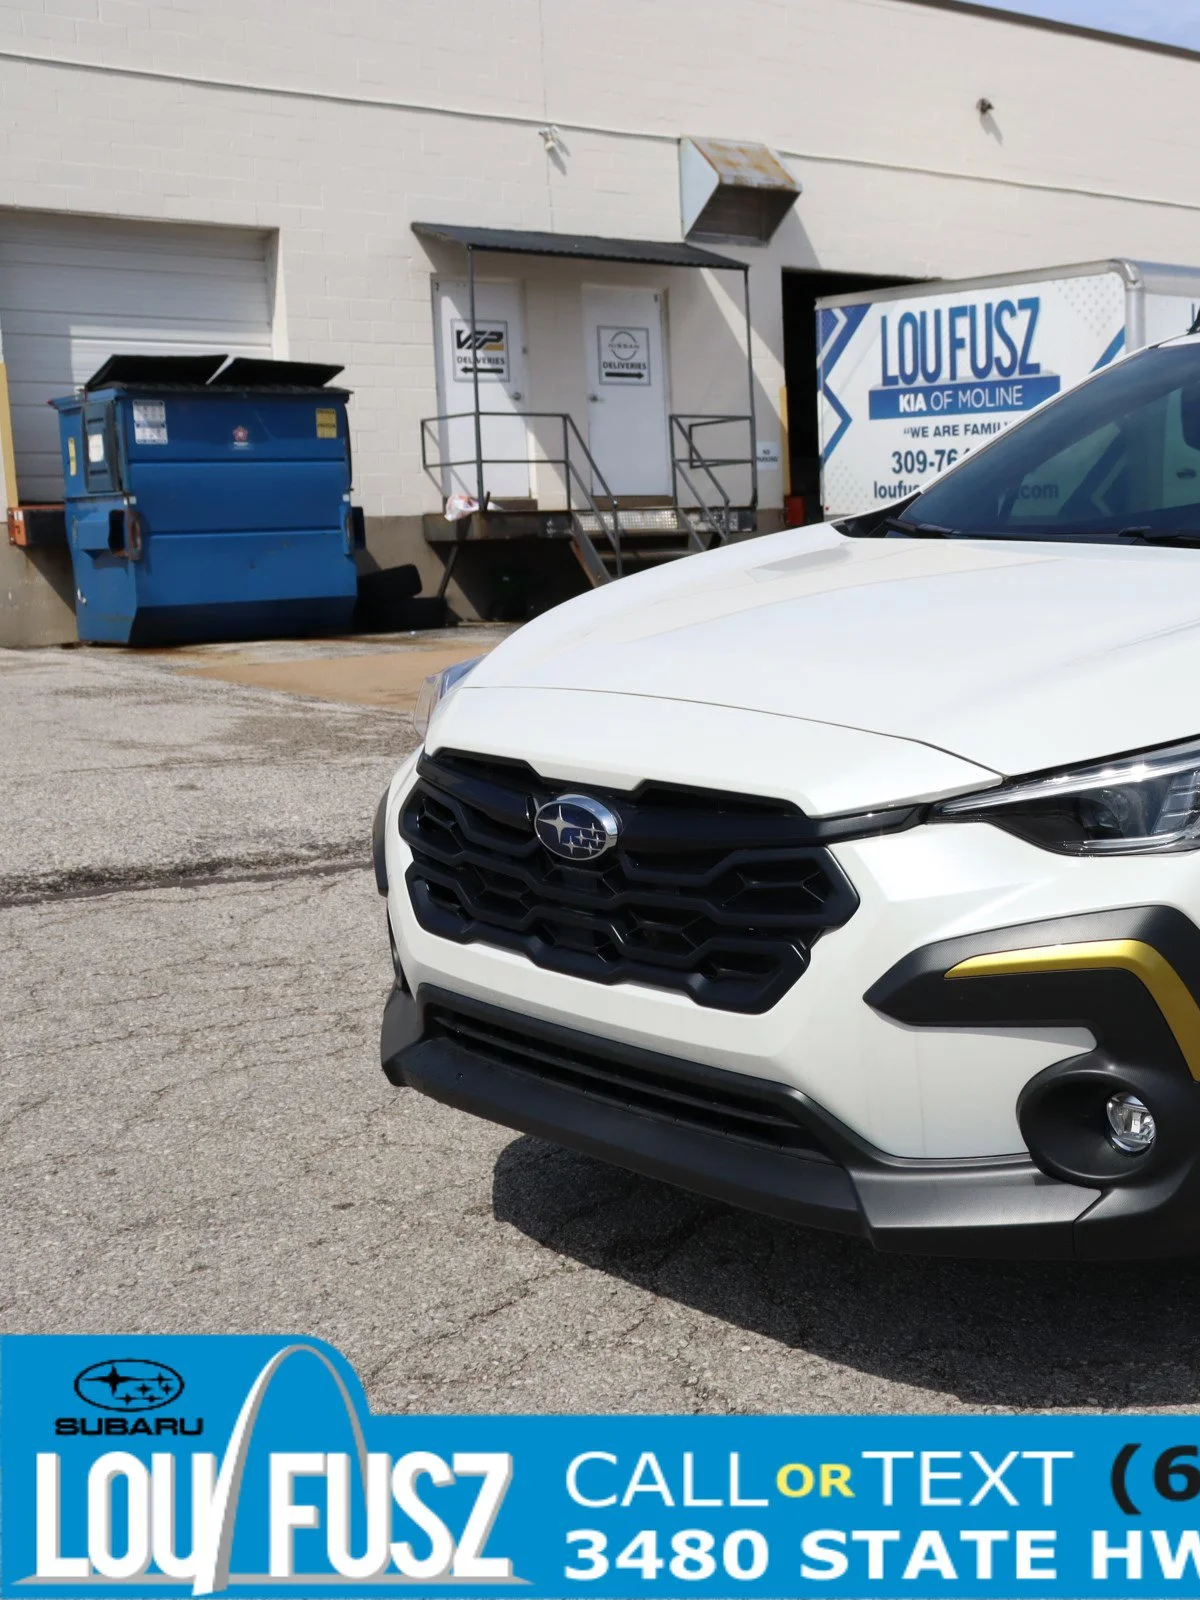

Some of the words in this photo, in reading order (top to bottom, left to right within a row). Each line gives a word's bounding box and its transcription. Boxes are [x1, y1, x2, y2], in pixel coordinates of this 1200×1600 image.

[881, 308, 942, 387] LOU
[948, 296, 1041, 381] FUSZ
[602, 361, 647, 370] DELIVERIES
[899, 394, 927, 413] KIA
[930, 391, 953, 410] OF
[958, 385, 1023, 409] MOLINE
[933, 424, 959, 437] ARE
